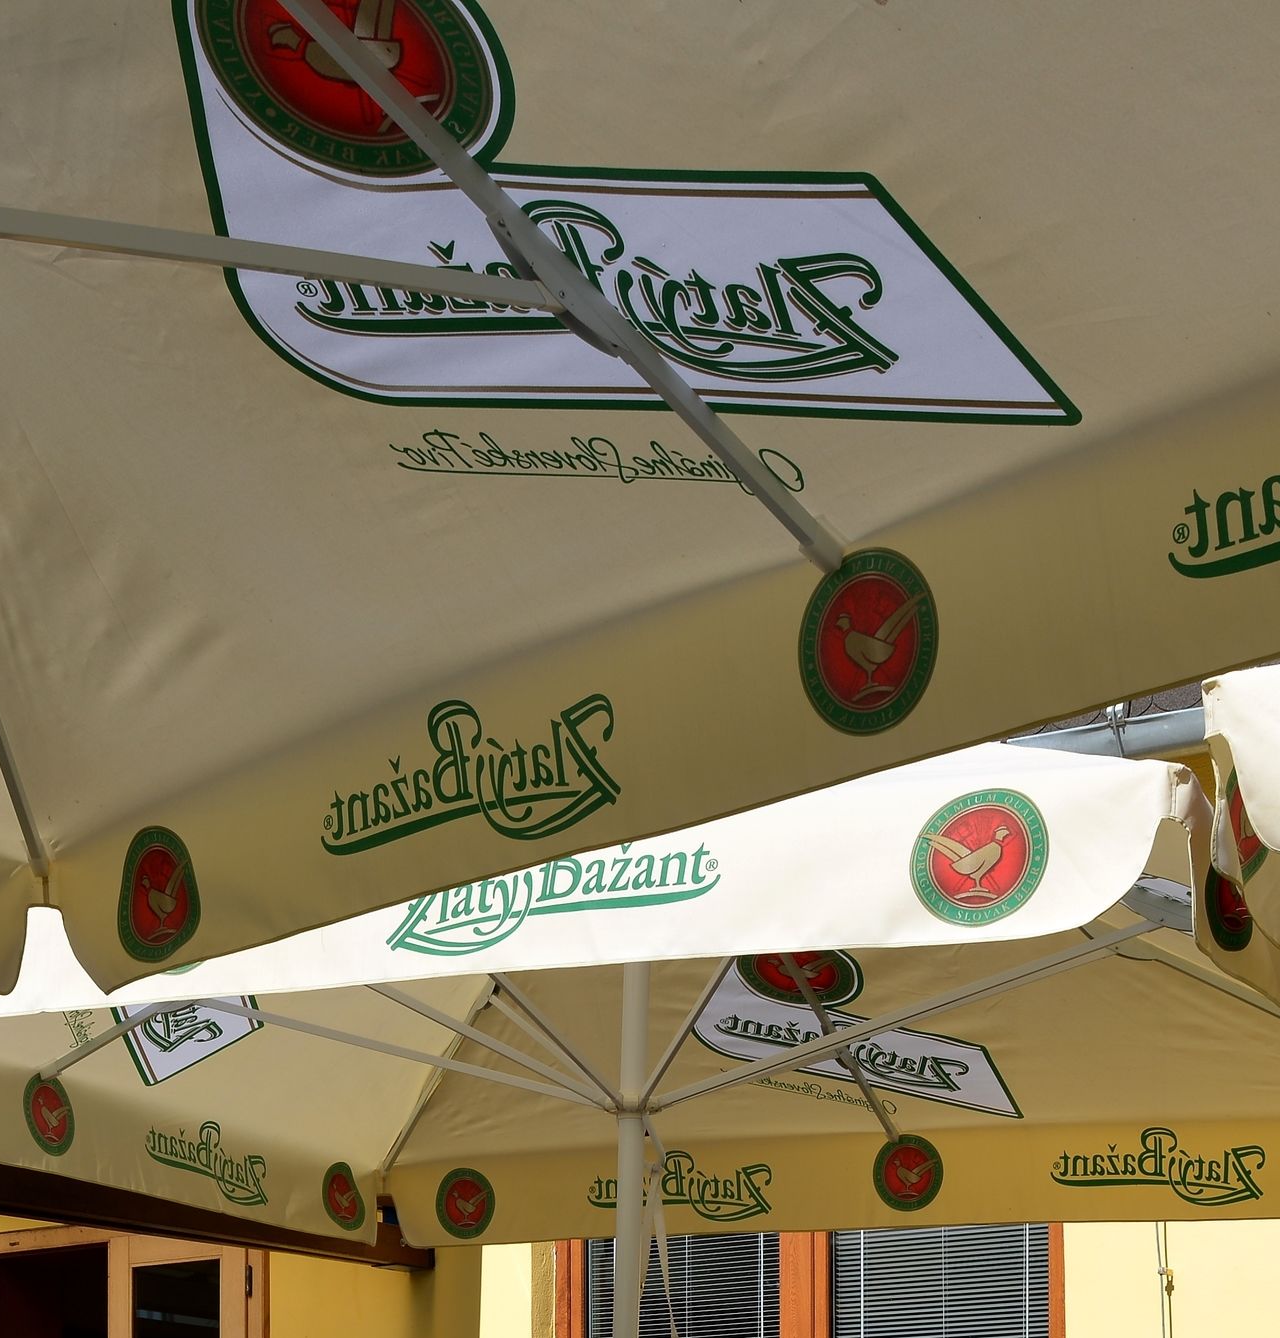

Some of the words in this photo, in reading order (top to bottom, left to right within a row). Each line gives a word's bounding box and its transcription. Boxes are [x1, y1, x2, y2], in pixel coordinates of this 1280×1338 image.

[1005, 795, 1043, 850] QUALITY
[916, 852, 950, 914] ORIGINAL
[955, 901, 1011, 922] SLOVAK
[1015, 866, 1040, 901] BEER
